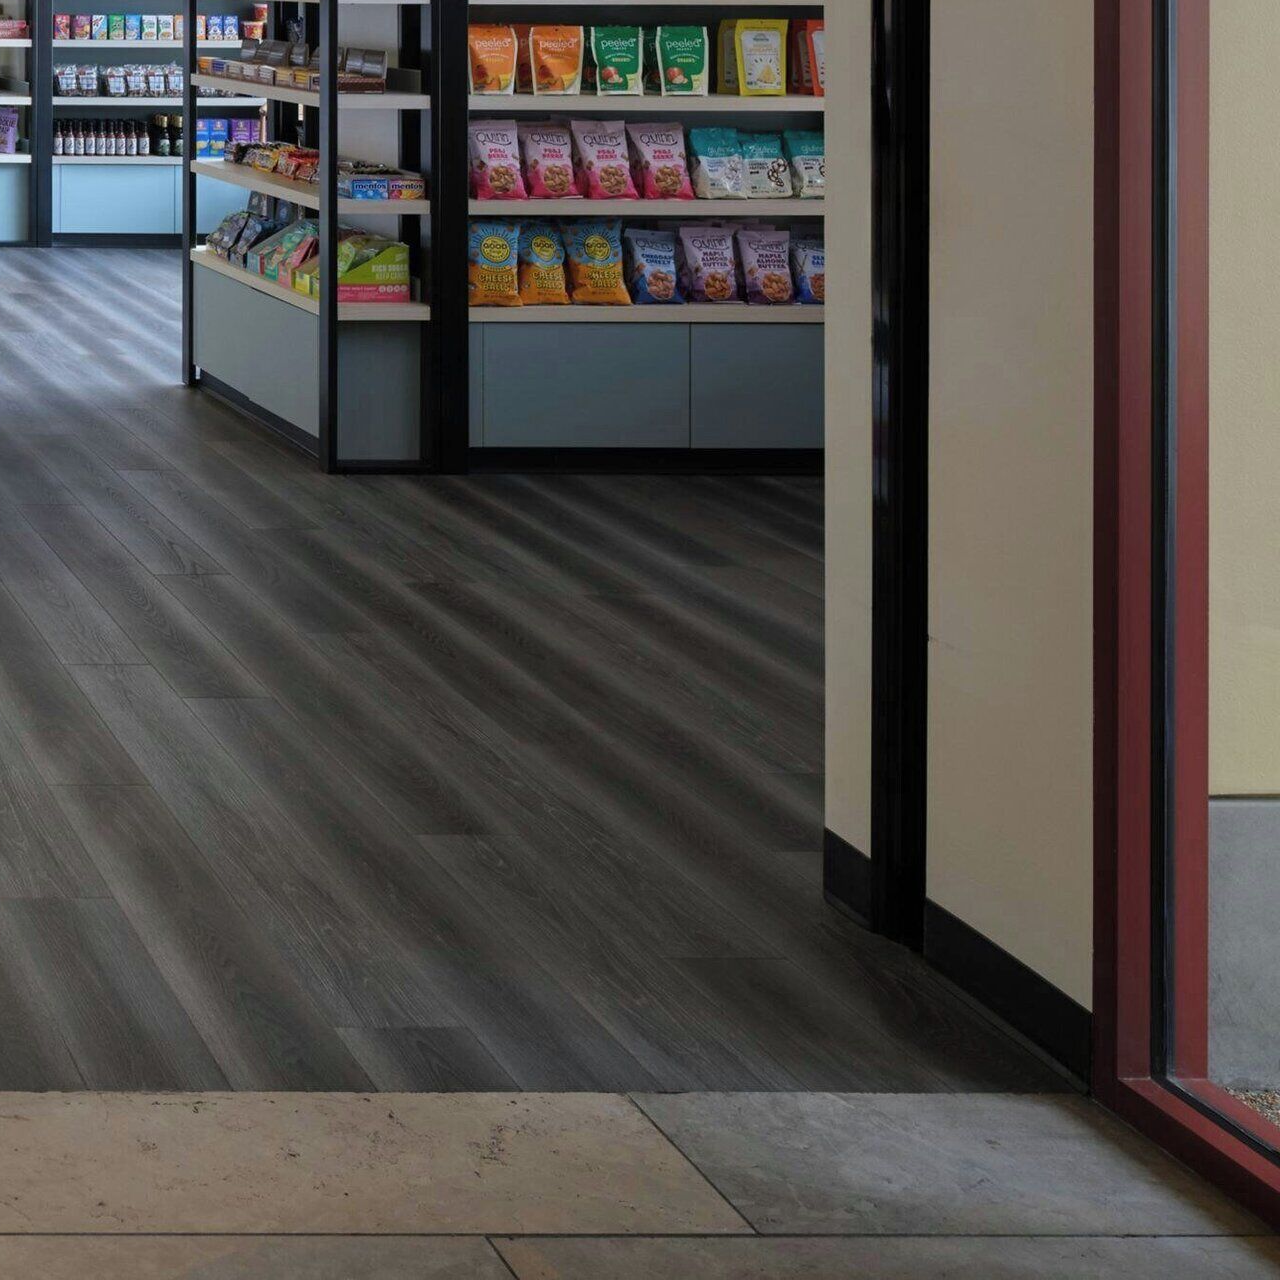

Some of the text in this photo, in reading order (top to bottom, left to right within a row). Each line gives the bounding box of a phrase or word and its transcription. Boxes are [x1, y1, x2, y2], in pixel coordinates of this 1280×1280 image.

[475, 38, 510, 50] peeled
[538, 38, 576, 49] peeled
[600, 37, 635, 50] peeled
[665, 37, 701, 51] peeled
[355, 182, 387, 190] mentos
[391, 182, 424, 190] mentos
